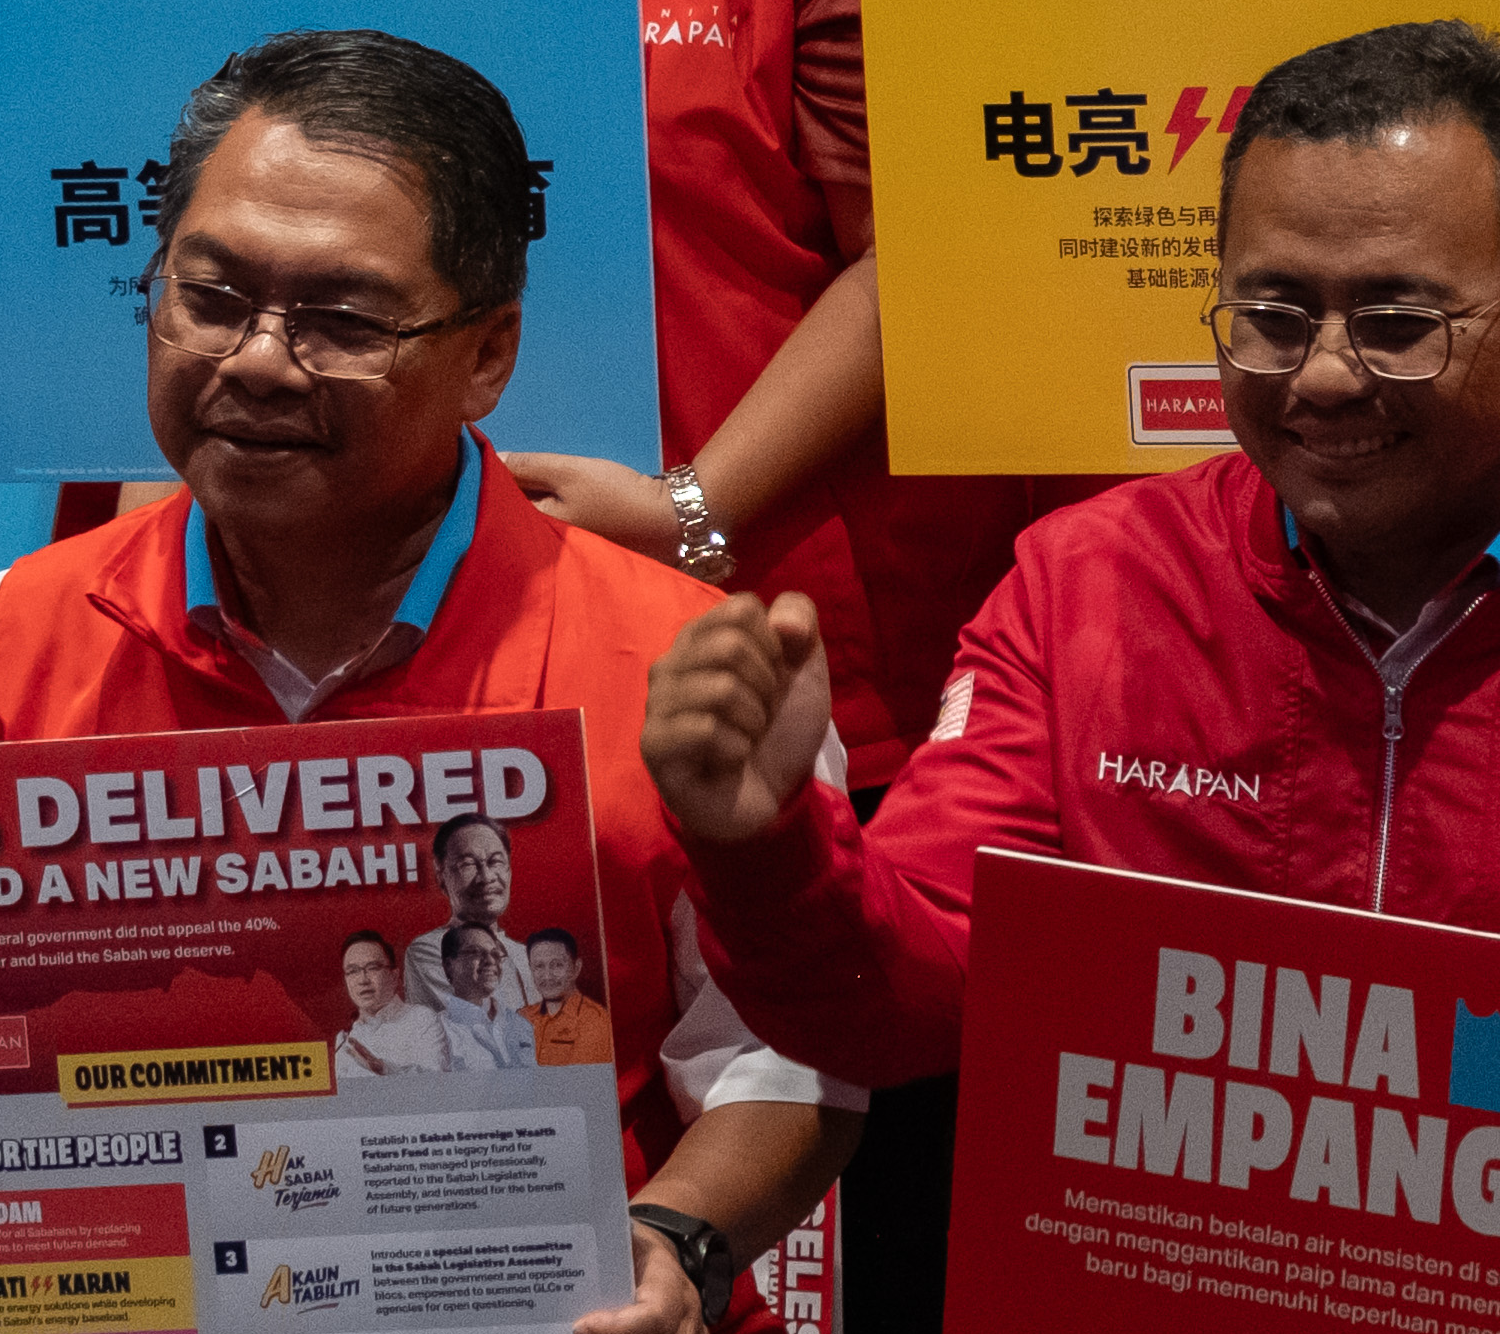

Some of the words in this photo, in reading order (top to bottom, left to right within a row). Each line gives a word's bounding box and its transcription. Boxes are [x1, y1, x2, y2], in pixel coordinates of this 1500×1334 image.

[981, 89, 1152, 178] 电亮
[16, 746, 549, 848] DELIVERED
[1098, 752, 1261, 803] HARAPAN
[37, 864, 75, 904] A
[87, 855, 202, 901] NEW
[215, 843, 420, 894] SABAH!
[26, 927, 112, 946] government
[114, 925, 137, 938] did
[139, 924, 164, 937] not
[166, 921, 215, 937] appeal
[217, 919, 241, 932] the
[244, 916, 280, 931] 40%.
[1152, 947, 1419, 1100] BINA
[75, 1065, 126, 1092] OUR
[130, 1054, 314, 1089] COMMITMENT:
[22, 1135, 77, 1169] THE
[77, 1131, 183, 1166] PEOPLE
[1024, 1212, 1110, 1244] dengan
[1115, 1231, 1279, 1275] menggantikan
[1284, 1262, 1335, 1288] paip
[1340, 1268, 1396, 1297] lama
[1400, 1280, 1445, 1306] dan
[1064, 1187, 1203, 1231] Memastikan
[1208, 1214, 1299, 1249] bekalan
[1303, 1235, 1334, 1255] air
[1338, 1238, 1453, 1277] konsisten
[1457, 1260, 1480, 1282] di
[59, 1272, 130, 1295] KARAN
